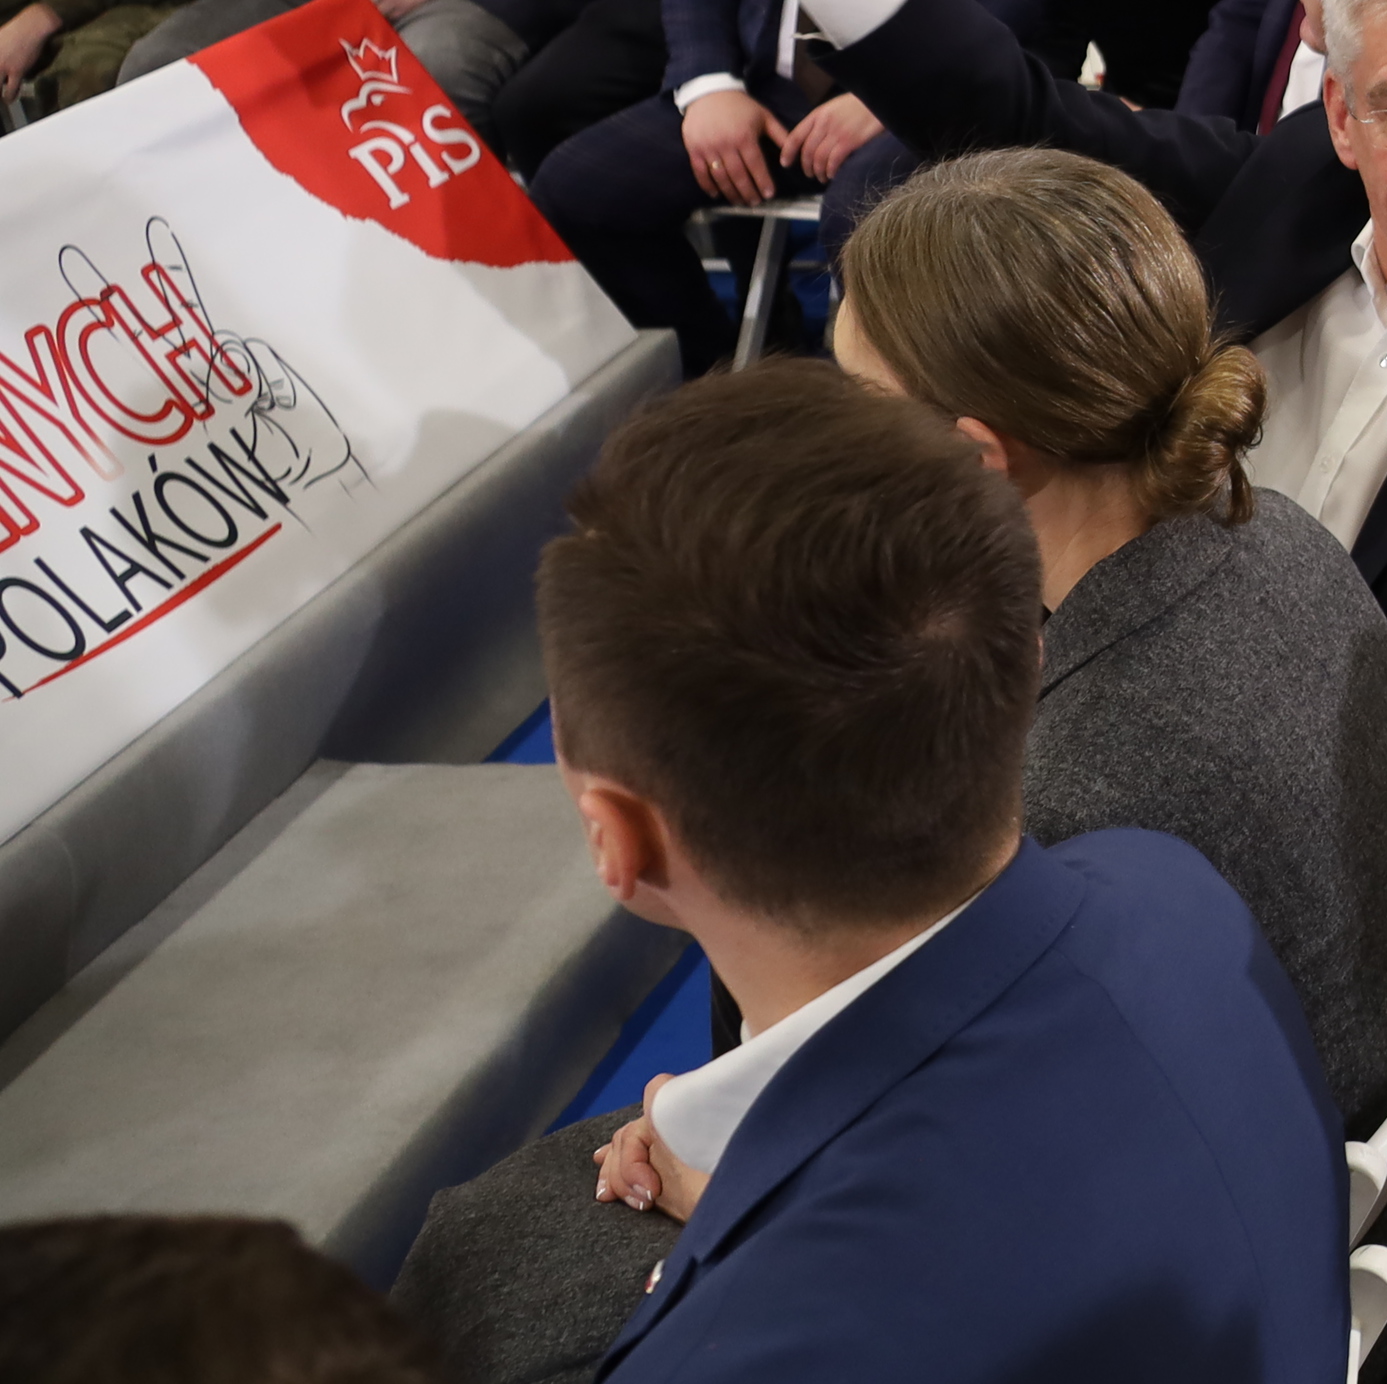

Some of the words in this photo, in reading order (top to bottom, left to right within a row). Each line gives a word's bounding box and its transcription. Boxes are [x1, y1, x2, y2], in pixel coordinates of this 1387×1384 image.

[348, 104, 481, 210] PiS
[0, 262, 253, 556] NYCH
[0, 427, 290, 699] OLAKÓW
